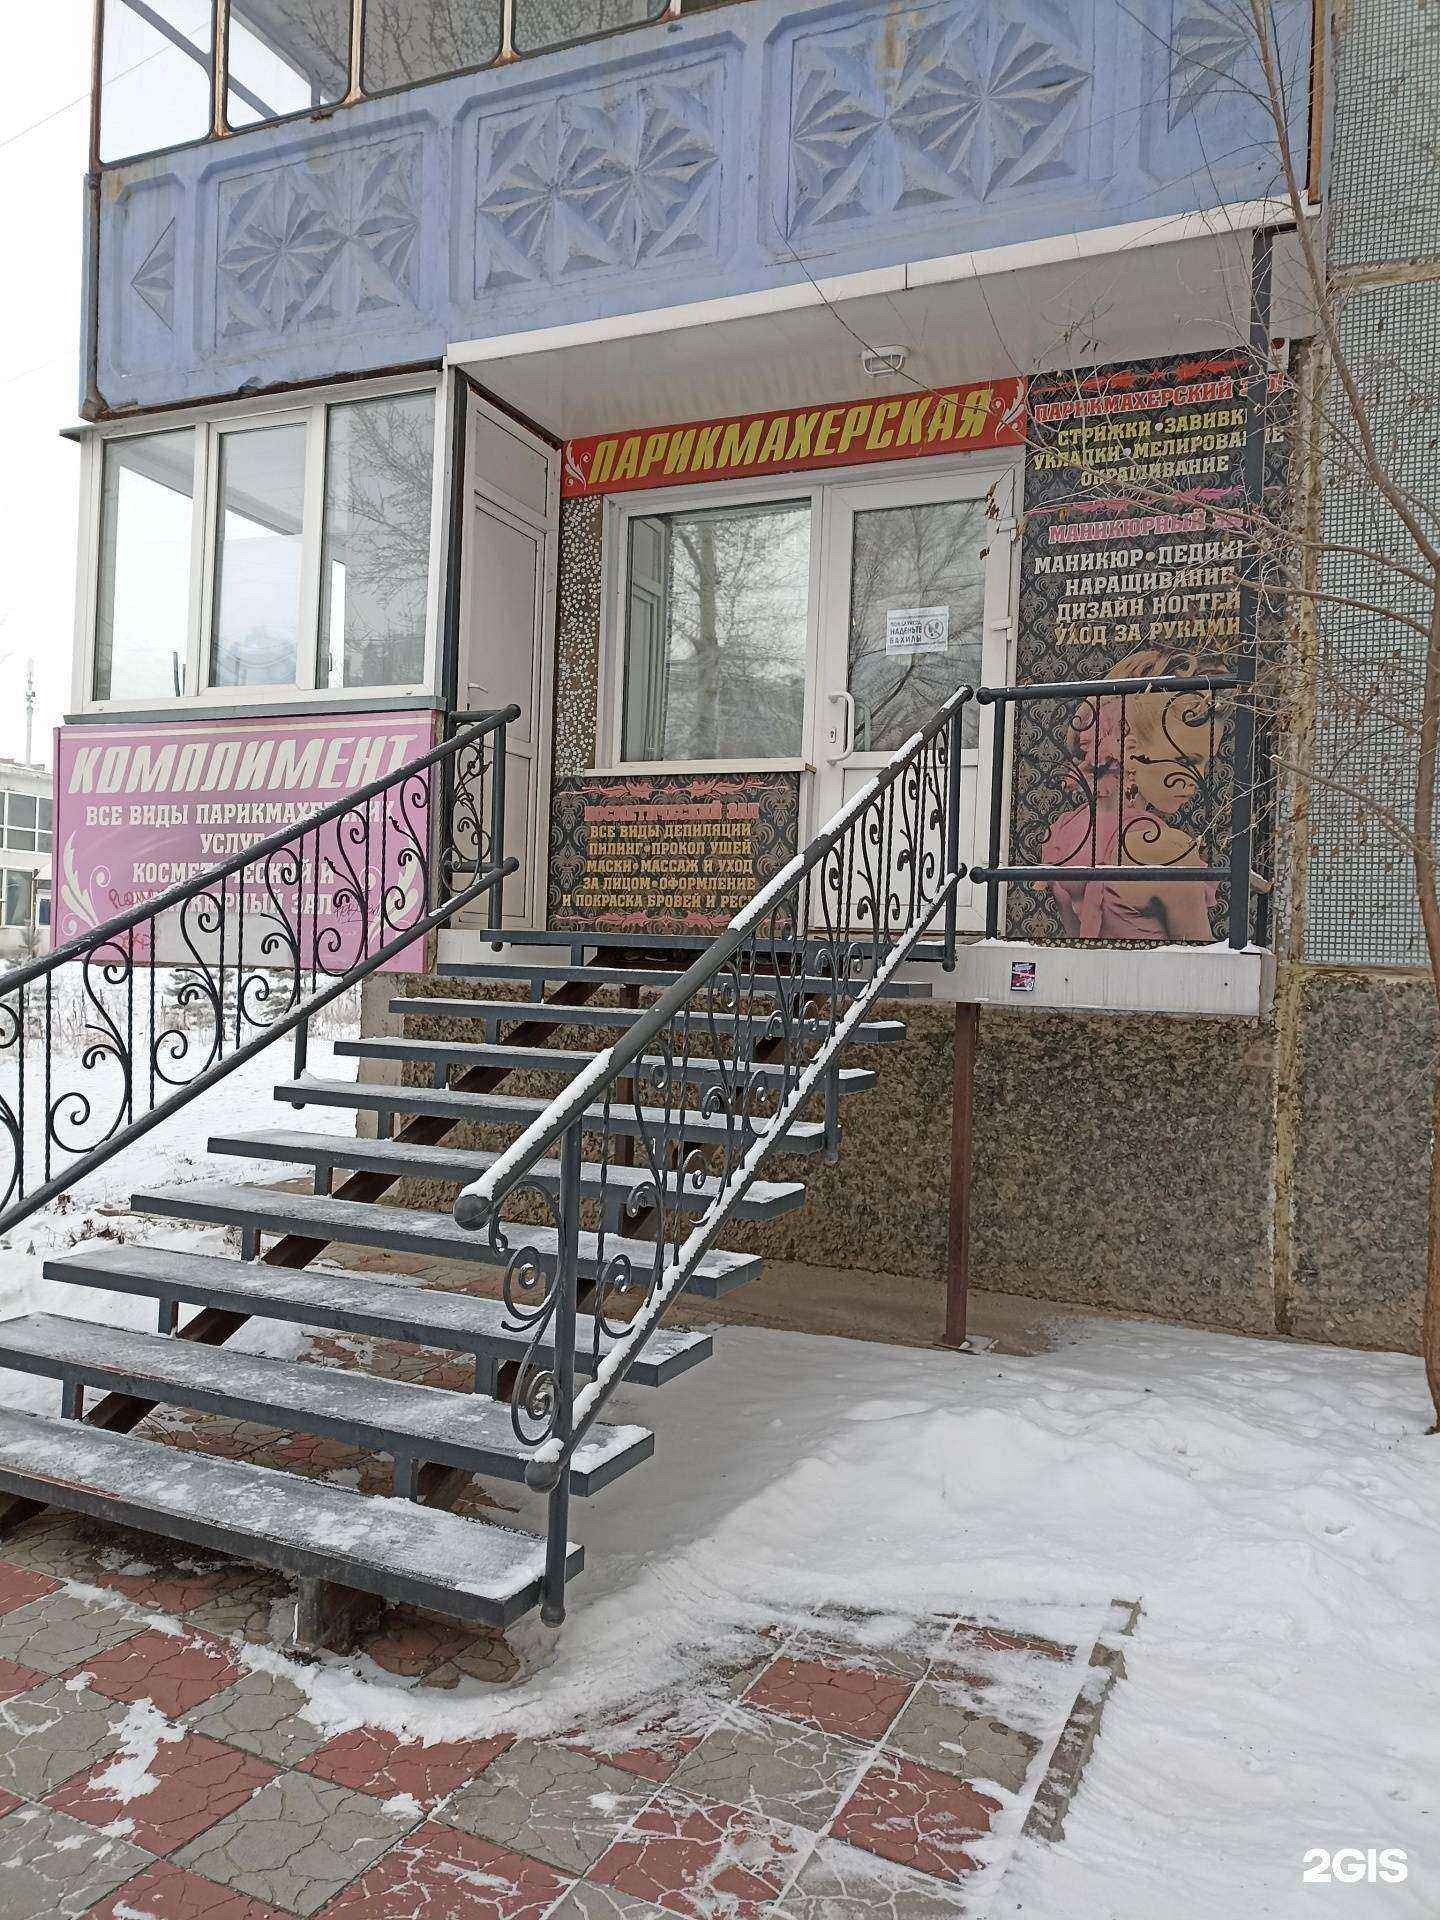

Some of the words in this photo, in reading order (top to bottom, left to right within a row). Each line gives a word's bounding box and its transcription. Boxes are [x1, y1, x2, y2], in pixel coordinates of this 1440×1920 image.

[1034, 377, 1233, 422] ПАРИКМАХЕРСКИЙ
[587, 388, 994, 485] ПАРИКМАХЕРСКАЯ
[1058, 420, 1151, 447] СТРИЖКИ
[1164, 408, 1248, 434] ЗАВИВК
[1034, 549, 1143, 575] МАНИКЮР
[1066, 566, 1236, 597] НАРАЩИВАНИЕ
[1056, 597, 1144, 623] ДИЗАЙН
[1054, 625, 1107, 646] УХОД
[1115, 624, 1142, 643] ЗА
[1150, 617, 1240, 640] РУКАМИ
[68, 734, 418, 794] КОМПЛИМЕНТ
[86, 804, 122, 827] ВСЕ
[129, 804, 189, 828] ВИДЫ
[590, 826, 616, 839] ВСЕ
[620, 825, 660, 839] ВИДЫ
[664, 824, 752, 838] ДЕПИЛЯЦИИ
[589, 842, 646, 855] ПИЛИНГ
[651, 841, 705, 855] ПРОКОЛ
[710, 839, 752, 853] УШЕЙ
[320, 864, 335, 884] И
[586, 860, 632, 873] МАСКИ
[641, 860, 699, 873] МАССАЖ
[704, 860, 713, 872] И
[718, 860, 753, 874] УХОД
[583, 878, 599, 890] ЗА
[603, 878, 651, 892] ЛИЦОМ
[659, 877, 756, 890] ОФОРМЛЕНИЕ
[562, 895, 571, 907] И
[576, 894, 643, 908] ПОКРАСКА
[648, 892, 701, 908] БРОВЕЙ
[706, 895, 715, 907] И
